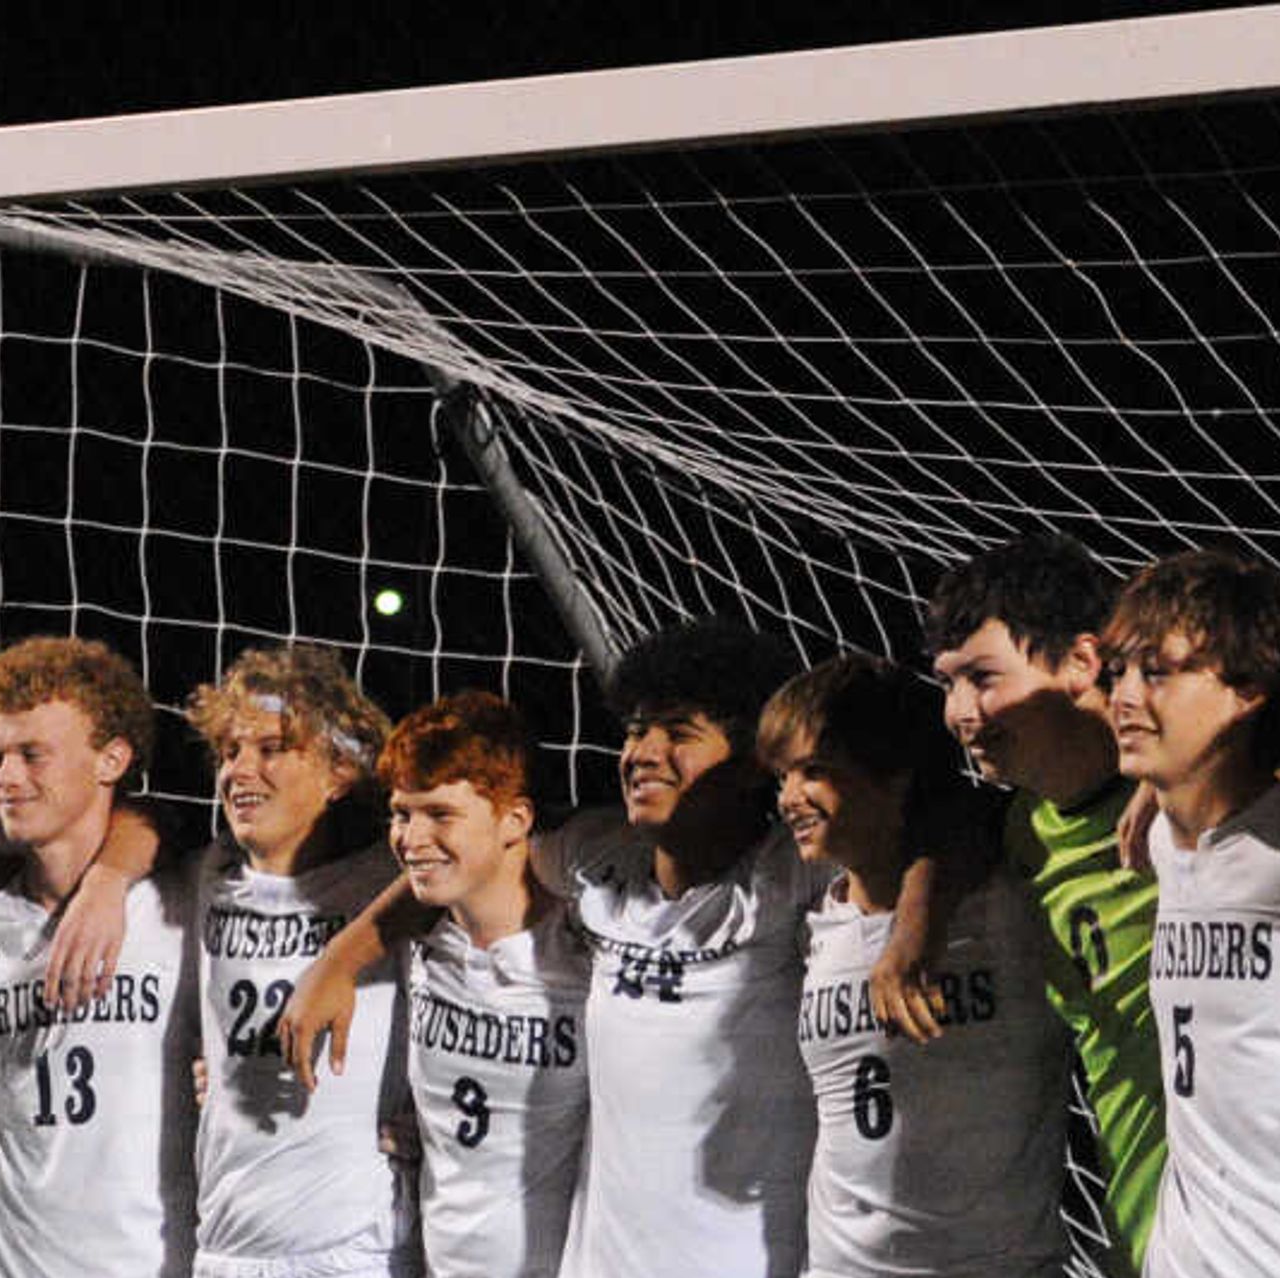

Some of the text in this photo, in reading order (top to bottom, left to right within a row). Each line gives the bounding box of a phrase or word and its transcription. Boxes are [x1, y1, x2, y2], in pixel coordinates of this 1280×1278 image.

[228, 979, 295, 1058] 22
[1173, 1005, 1196, 1099] 5
[33, 1045, 97, 1127] 13
[853, 1055, 894, 1140] 6
